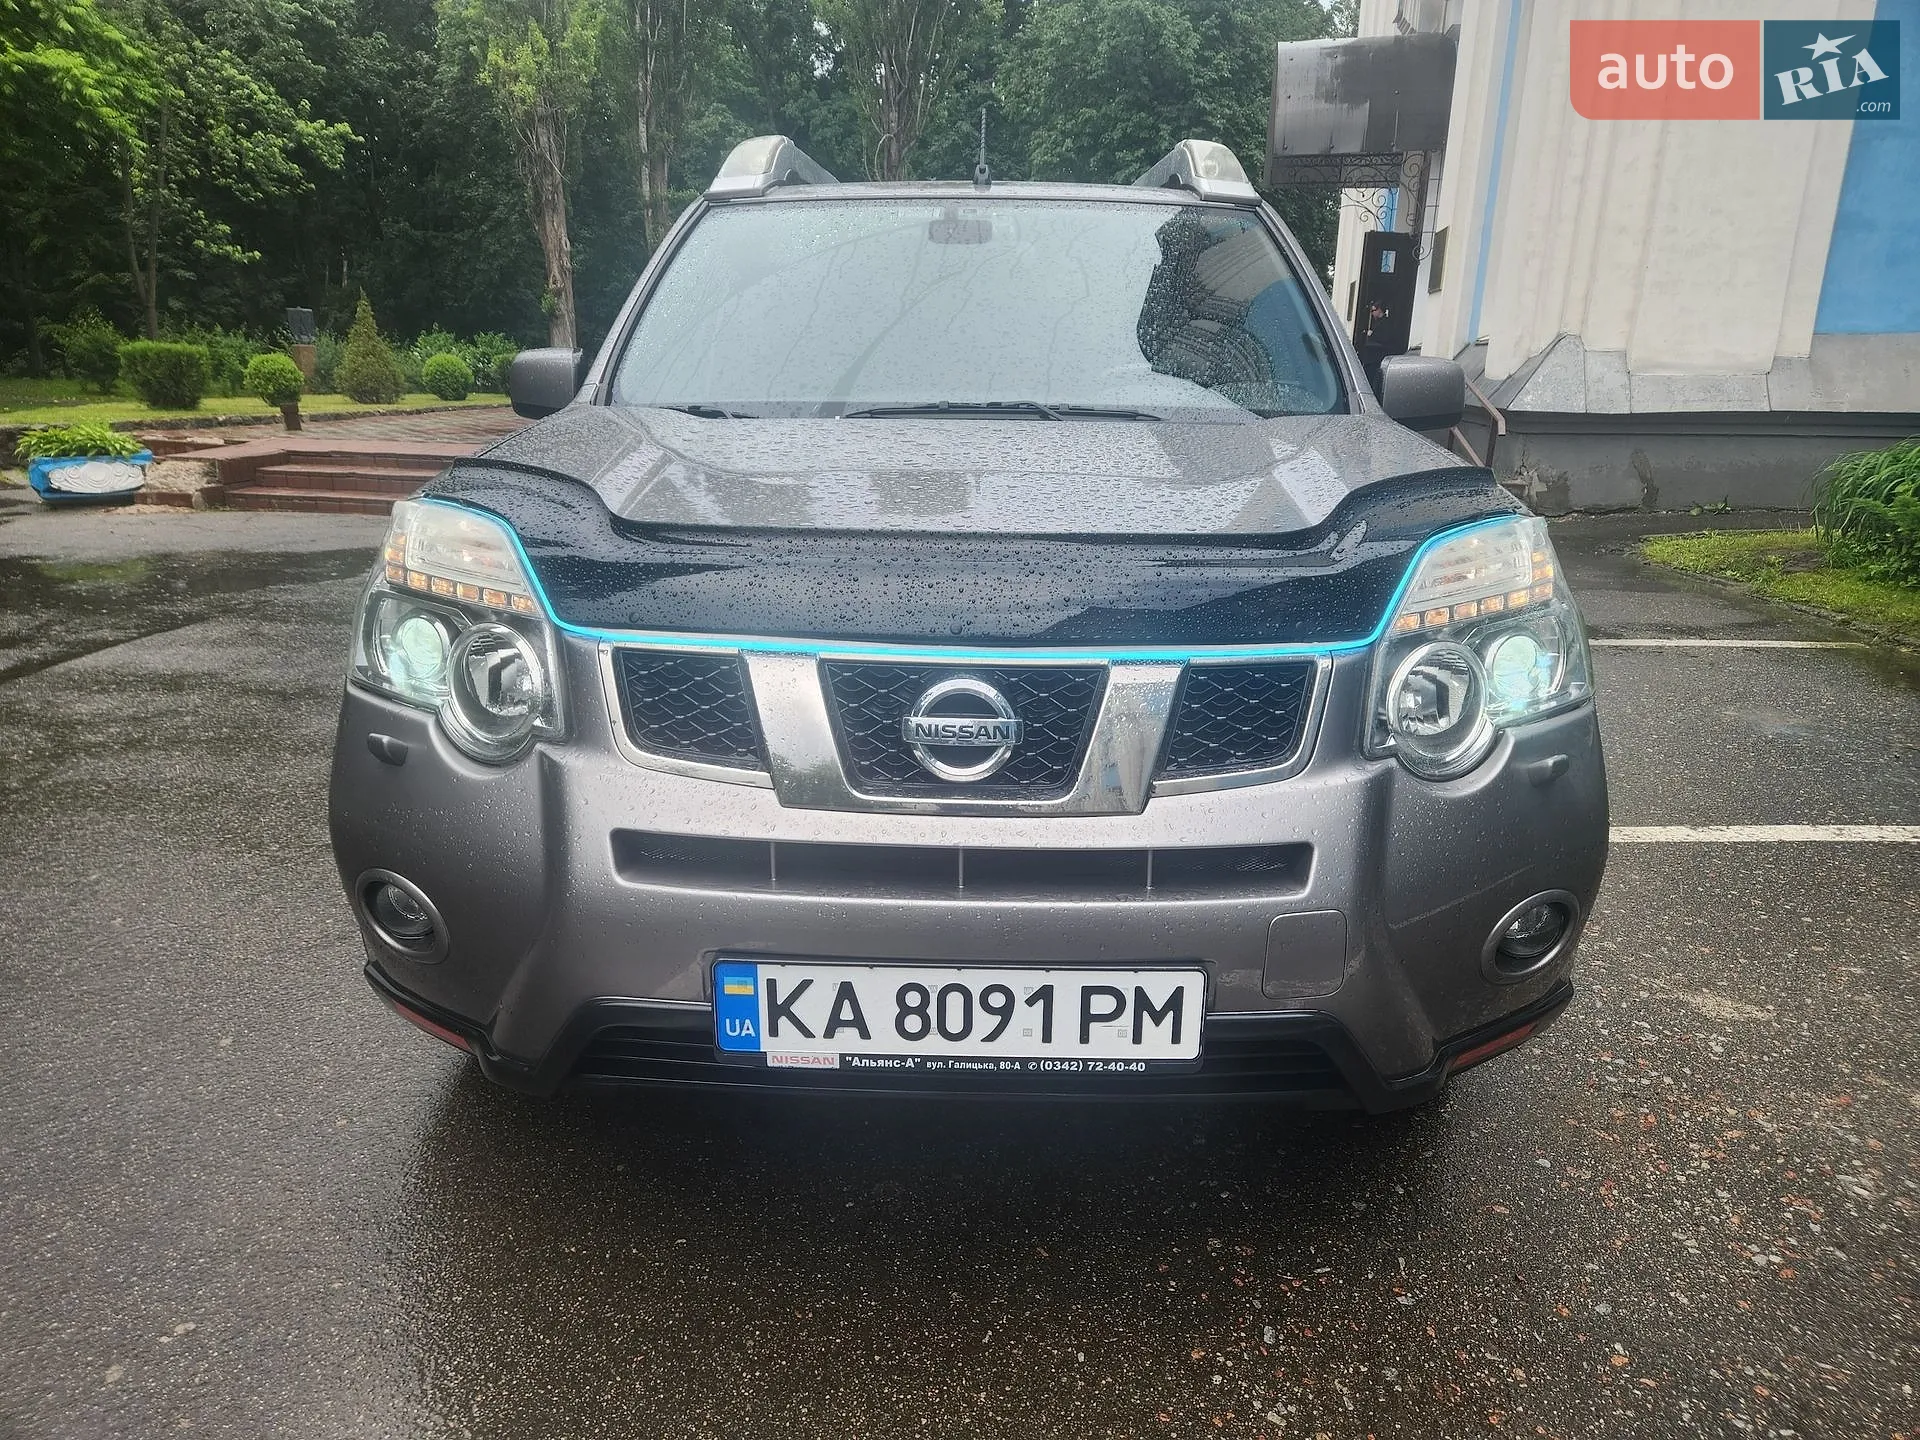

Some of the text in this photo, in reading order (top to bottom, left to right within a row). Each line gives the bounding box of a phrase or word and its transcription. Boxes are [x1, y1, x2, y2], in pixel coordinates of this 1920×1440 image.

[914, 722, 1011, 741] NISSAN
[766, 977, 1185, 1045] KA 8091 PM
[725, 1017, 756, 1038] UA
[771, 1054, 835, 1066] NISSAN
[845, 1055, 921, 1069] "Альянс-А"
[926, 1060, 946, 1070] вул.
[948, 1060, 997, 1072] Галицька,
[1039, 1060, 1083, 1072] (0342)
[1087, 1061, 1146, 1073] 72-40-40
